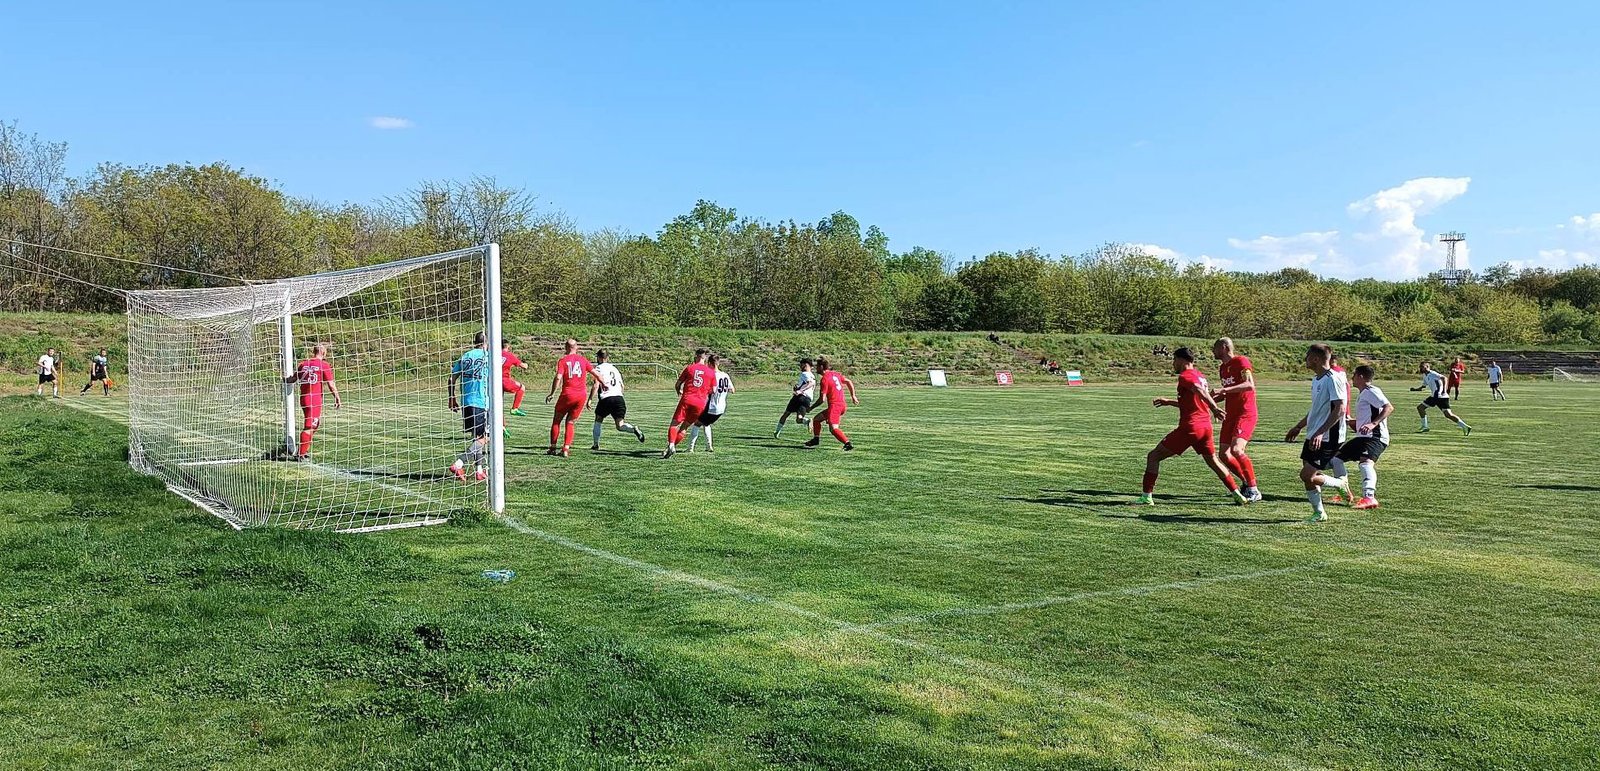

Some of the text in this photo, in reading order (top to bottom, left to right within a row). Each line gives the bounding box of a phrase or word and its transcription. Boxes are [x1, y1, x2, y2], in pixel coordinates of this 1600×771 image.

[298, 366, 319, 384] 25
[463, 357, 483, 379] 22
[566, 361, 582, 378] 14
[609, 371, 616, 386] 3
[693, 369, 704, 387] 5
[718, 377, 728, 393] 99
[832, 375, 842, 391] 3
